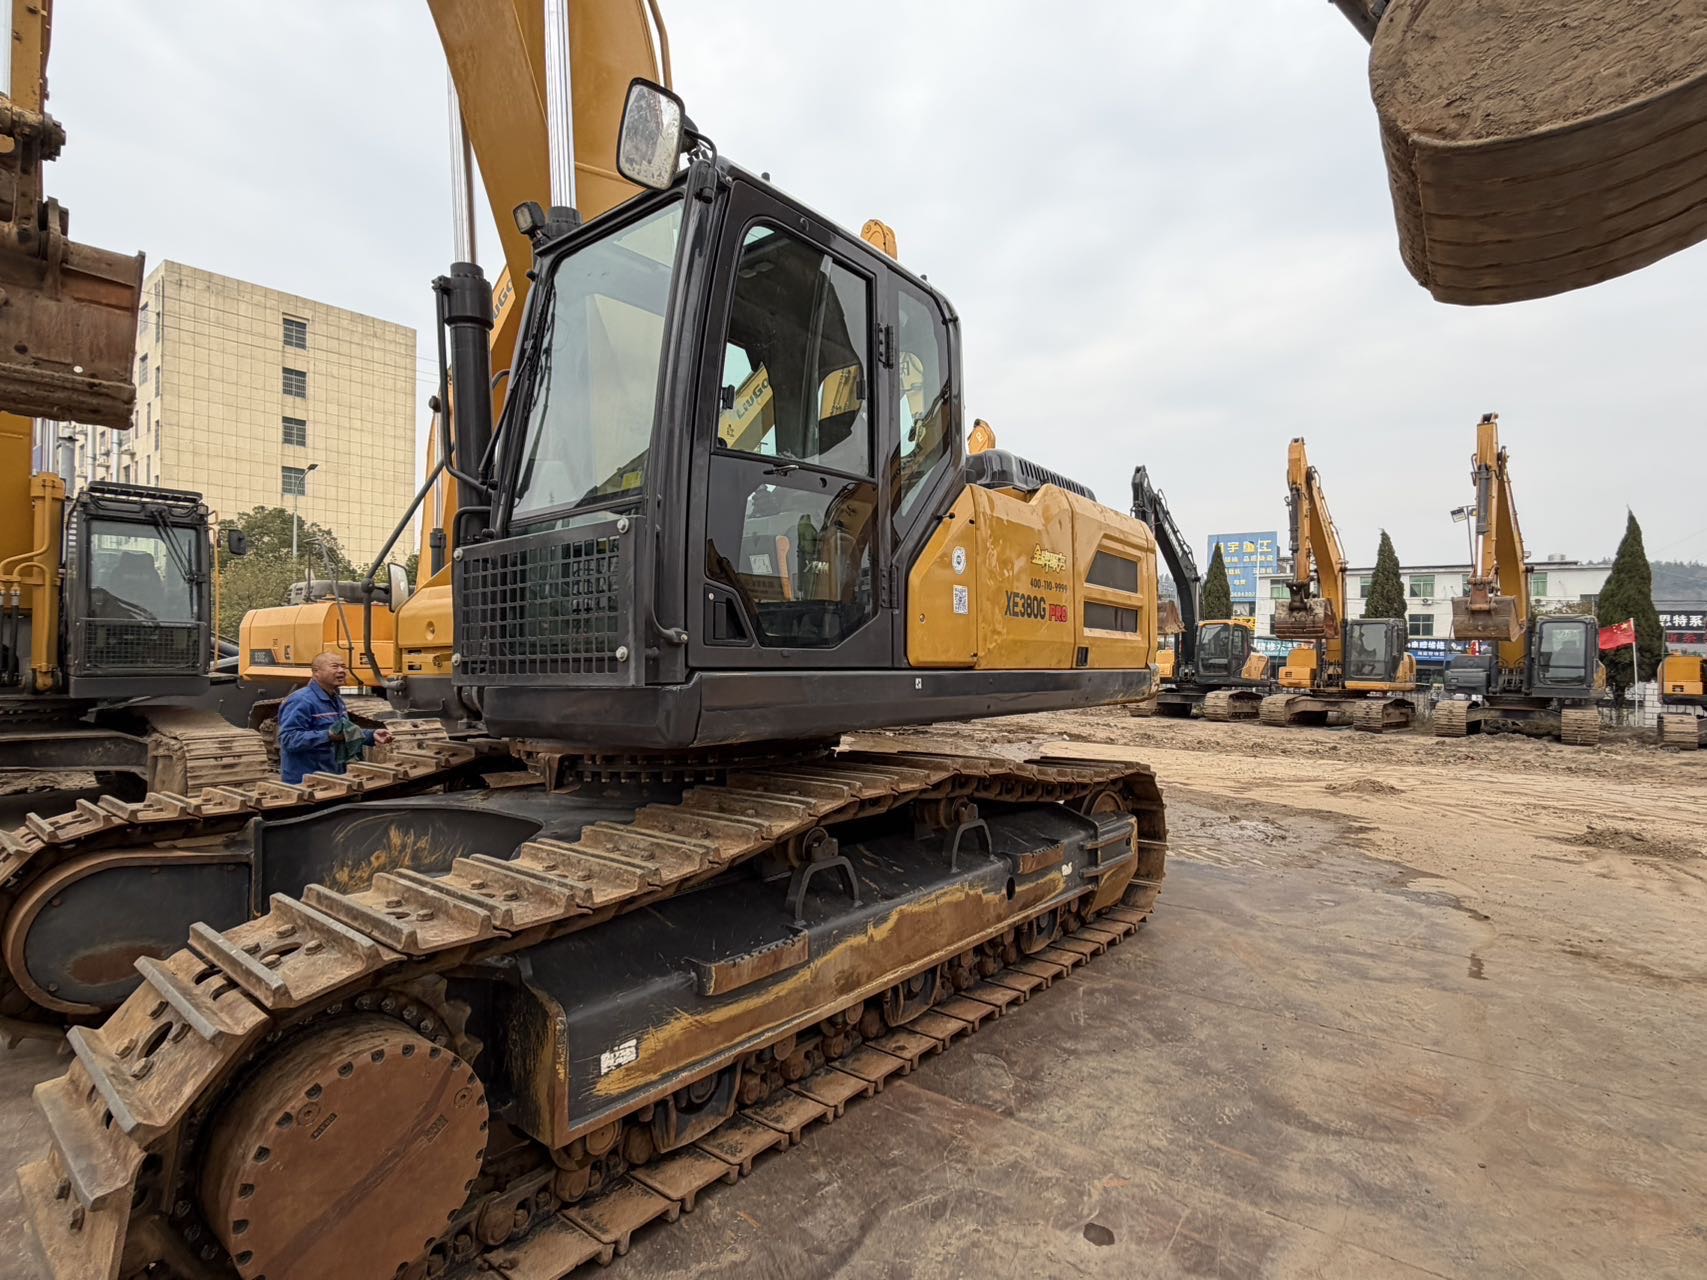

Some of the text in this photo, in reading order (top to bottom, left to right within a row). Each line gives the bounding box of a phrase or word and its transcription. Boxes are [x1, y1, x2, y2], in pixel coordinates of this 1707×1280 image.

[1030, 577, 1068, 594] 400-110-9999
[1004, 590, 1069, 623] XE380G PRO
